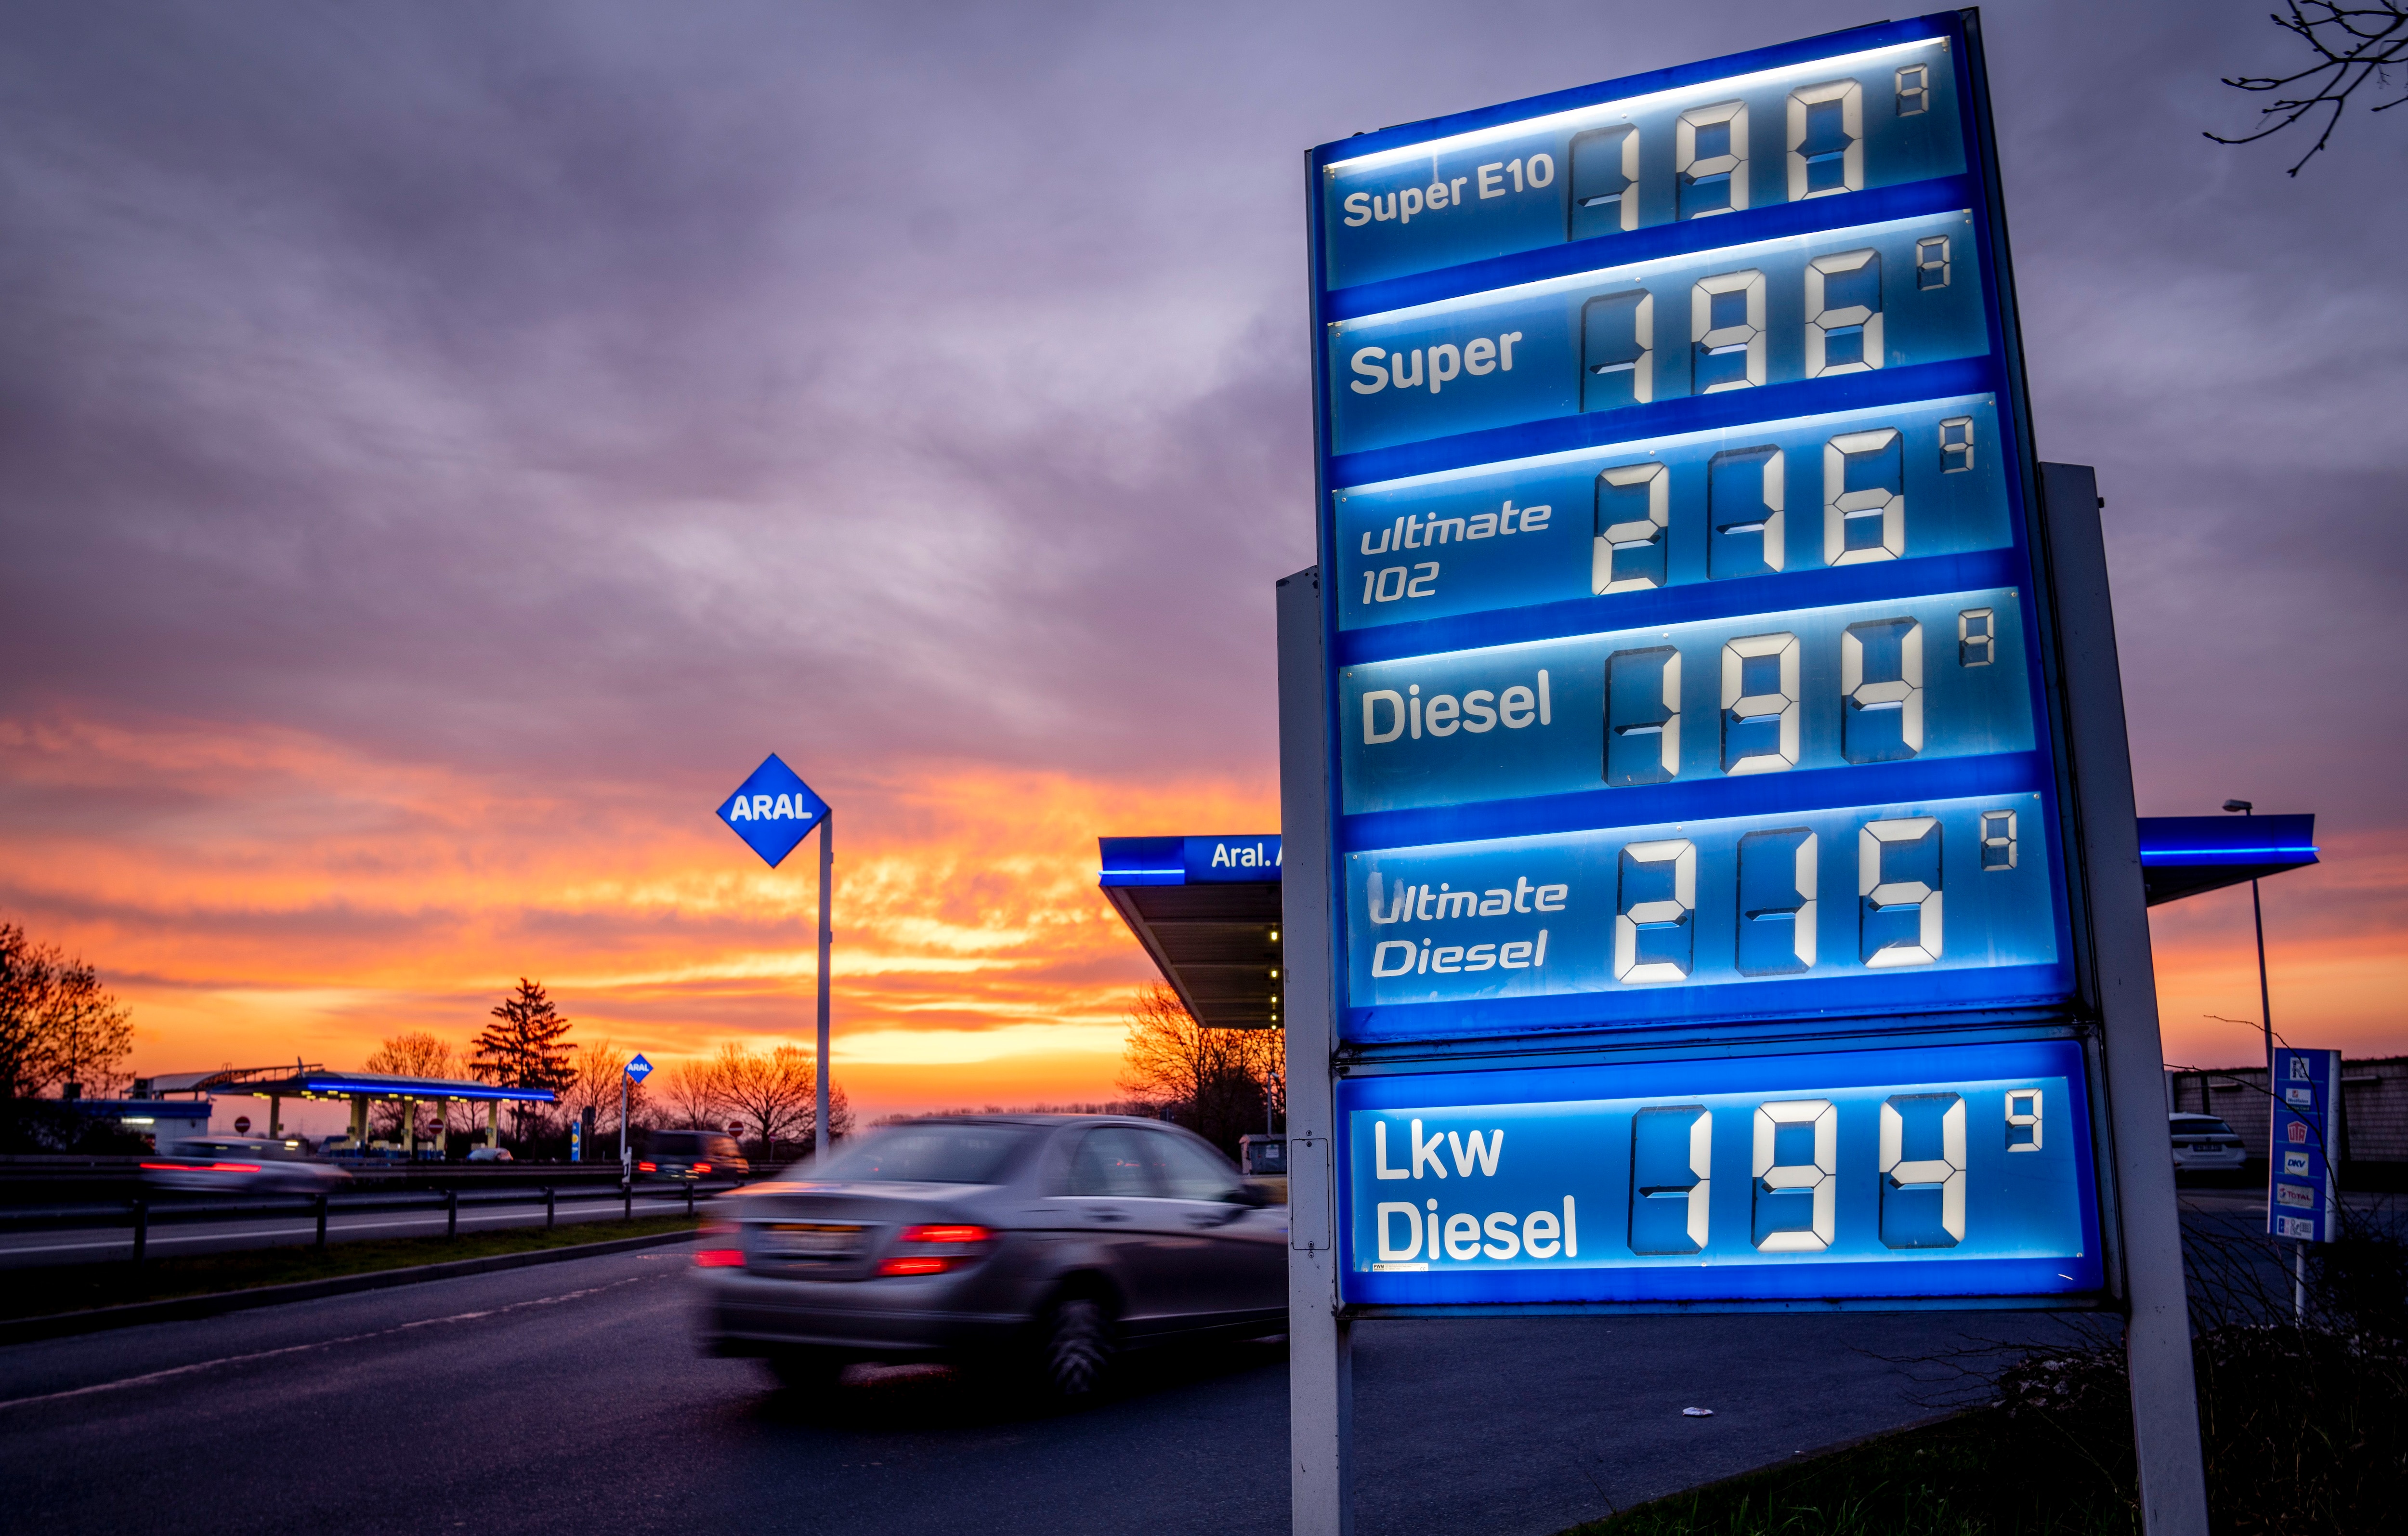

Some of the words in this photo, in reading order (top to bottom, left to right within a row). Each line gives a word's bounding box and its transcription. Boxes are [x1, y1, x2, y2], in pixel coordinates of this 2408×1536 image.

[1344, 175, 1467, 227] Super
[1478, 153, 1555, 200] E10
[1350, 331, 1522, 394] Super
[1361, 500, 1552, 555] ultimate
[1362, 562, 1440, 604] 102
[1362, 670, 1551, 745] Diesel
[730, 793, 813, 822] ARAL
[1211, 843, 1271, 867] Aral.
[1371, 930, 1548, 978] Diesel
[628, 1063, 649, 1072] ARAL
[1375, 1118, 1504, 1180] Lkw
[2289, 1122, 2306, 1142] UTA
[2288, 1159, 2305, 1167] DKV
[1377, 1195, 1578, 1261] Diesel
